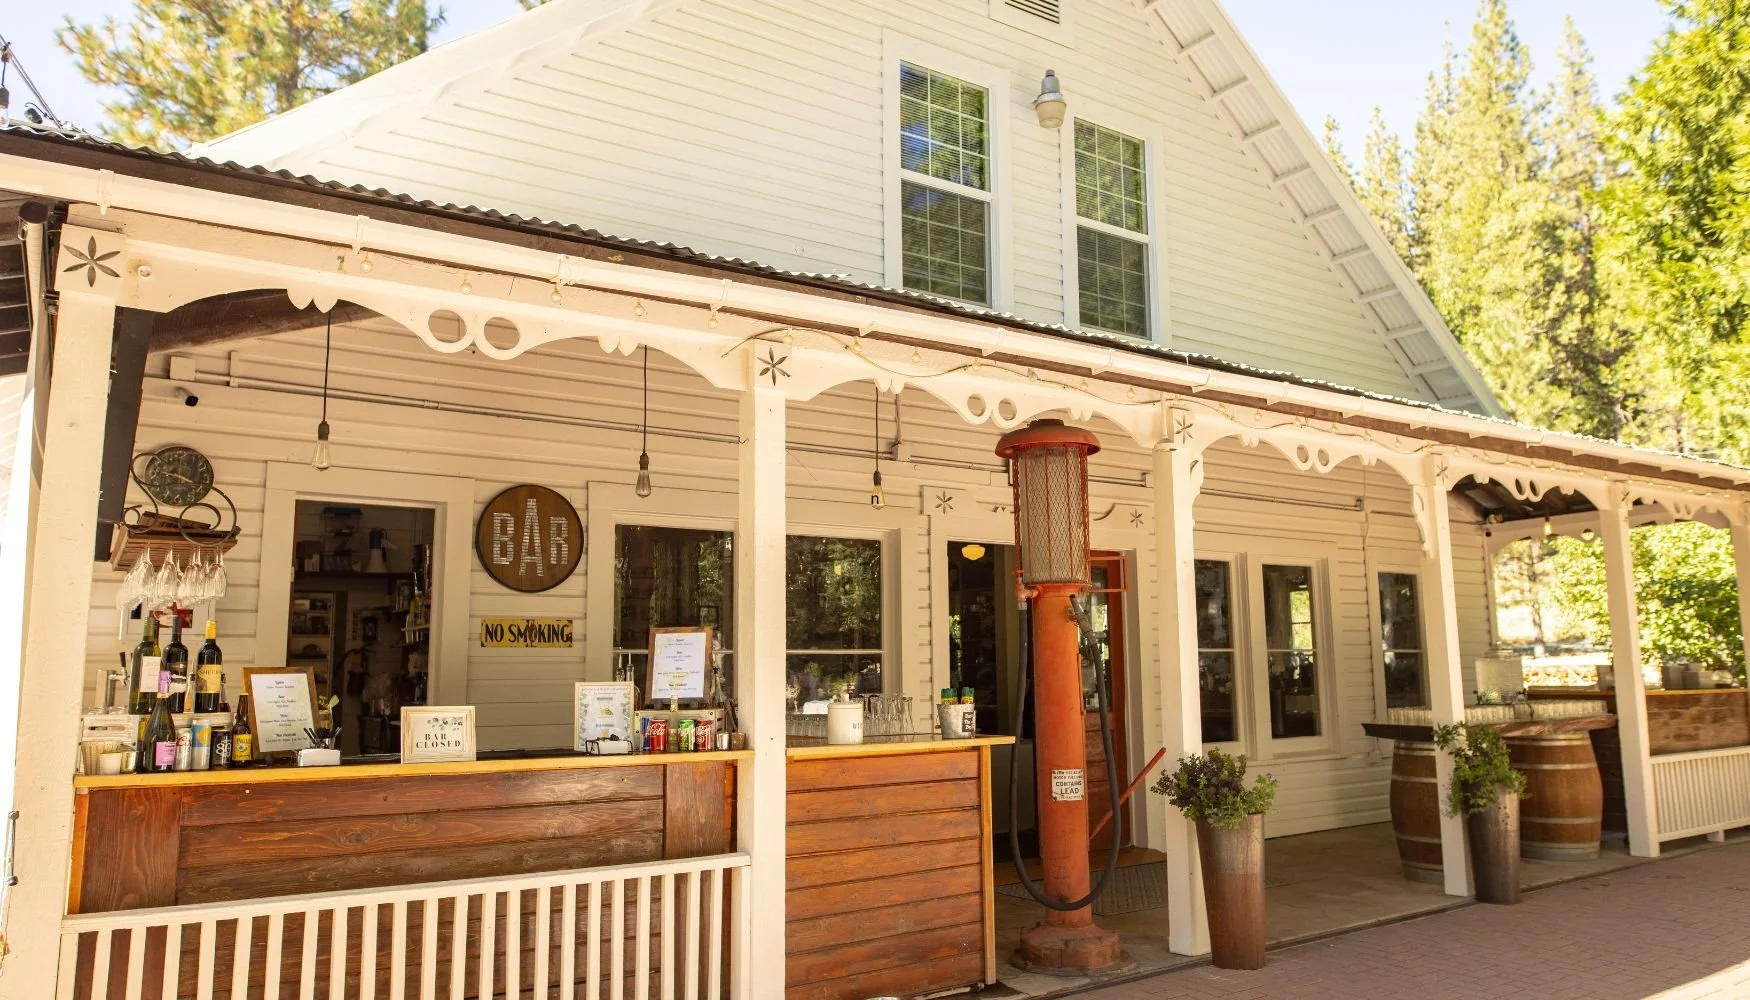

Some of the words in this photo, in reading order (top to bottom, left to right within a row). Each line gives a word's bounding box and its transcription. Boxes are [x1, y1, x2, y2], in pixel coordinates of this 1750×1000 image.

[493, 498, 568, 576] BAR
[485, 623, 504, 643] NO
[508, 623, 569, 643] SMOKING
[416, 740, 461, 748] CLOSED
